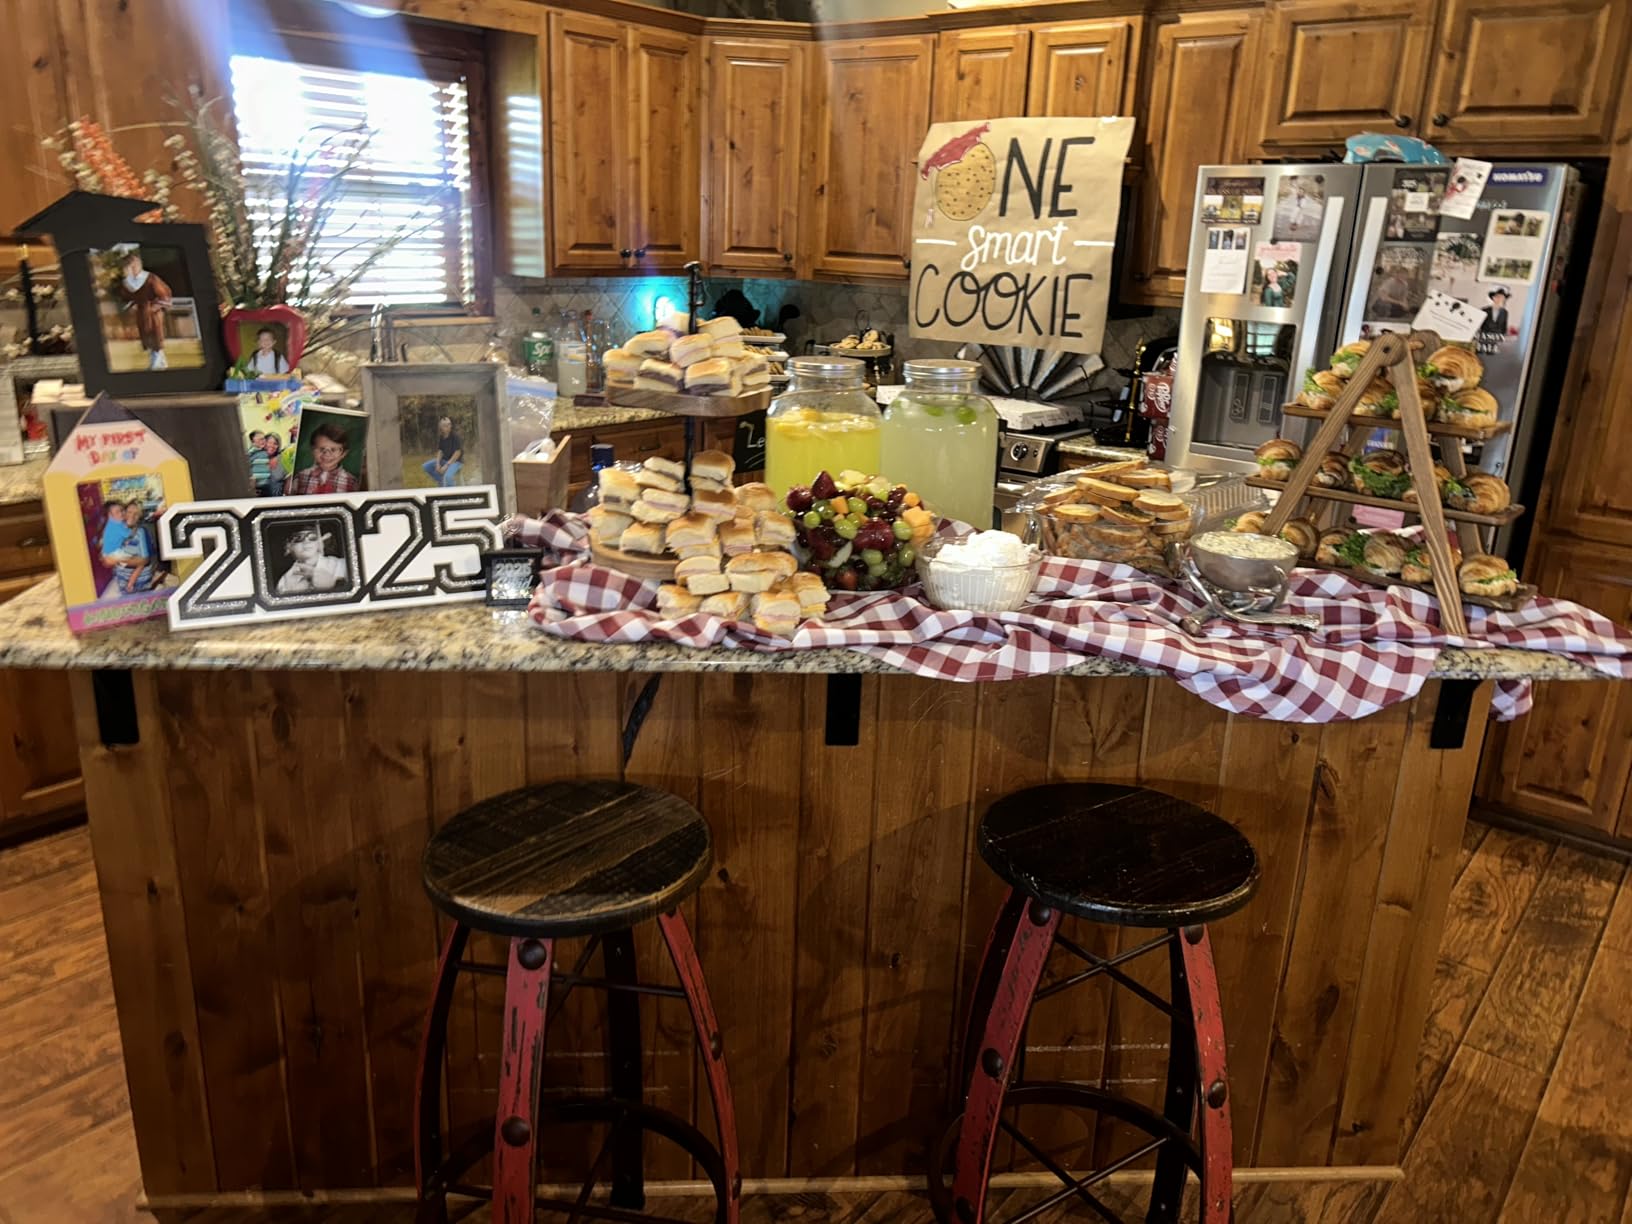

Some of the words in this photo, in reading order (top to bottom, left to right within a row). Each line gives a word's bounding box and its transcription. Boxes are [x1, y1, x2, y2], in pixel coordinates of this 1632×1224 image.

[960, 221, 1068, 272] smart
[915, 264, 1093, 338] COOKIE
[75, 434, 97, 451] MY
[101, 429, 146, 446] FIRST
[89, 449, 117, 465] DAY
[122, 447, 139, 461] OF
[167, 488, 497, 621] 2025
